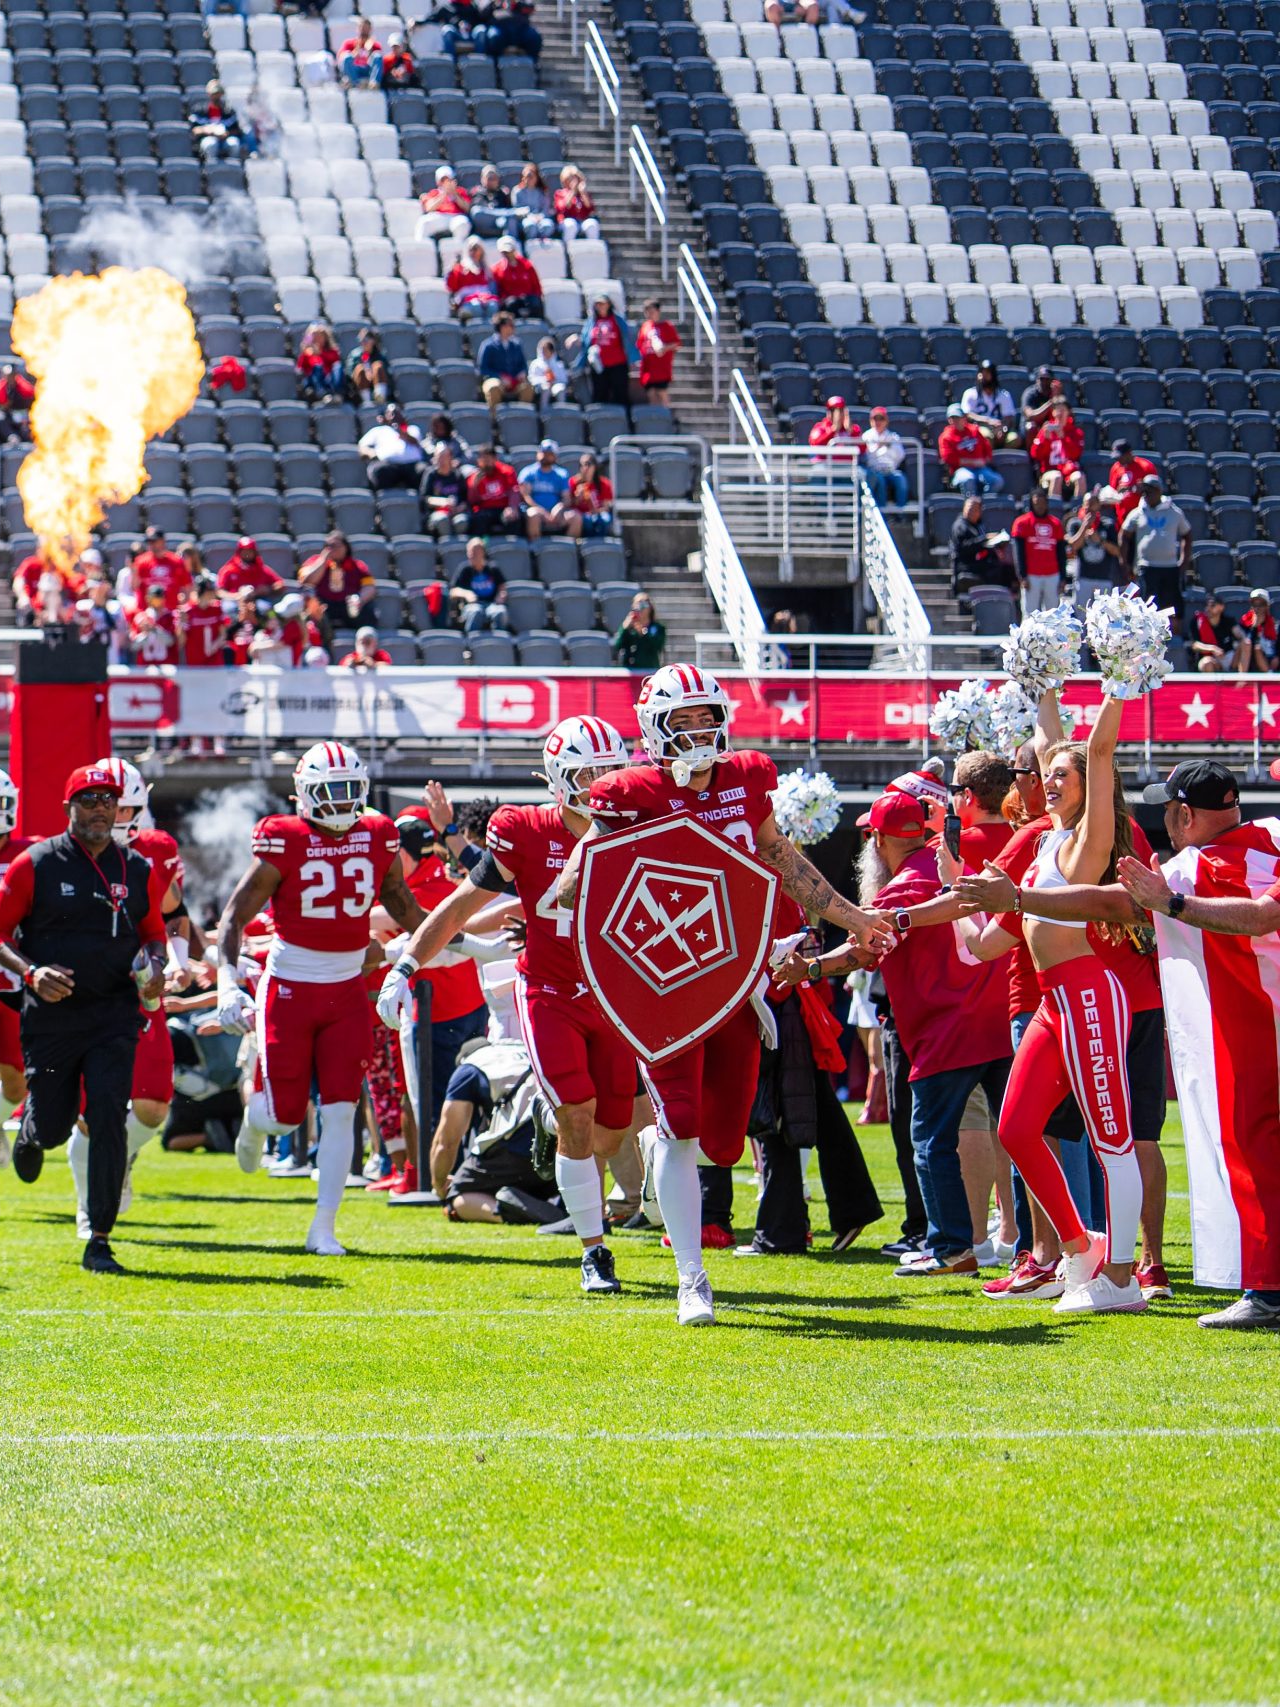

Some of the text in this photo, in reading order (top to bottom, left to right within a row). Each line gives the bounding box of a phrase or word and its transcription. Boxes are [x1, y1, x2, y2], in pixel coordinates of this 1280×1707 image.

[306, 843, 370, 858] DEFENDERS
[299, 857, 376, 920] 23
[1080, 988, 1118, 1136] DEFENDERS
[1107, 1055, 1115, 1073] DC
